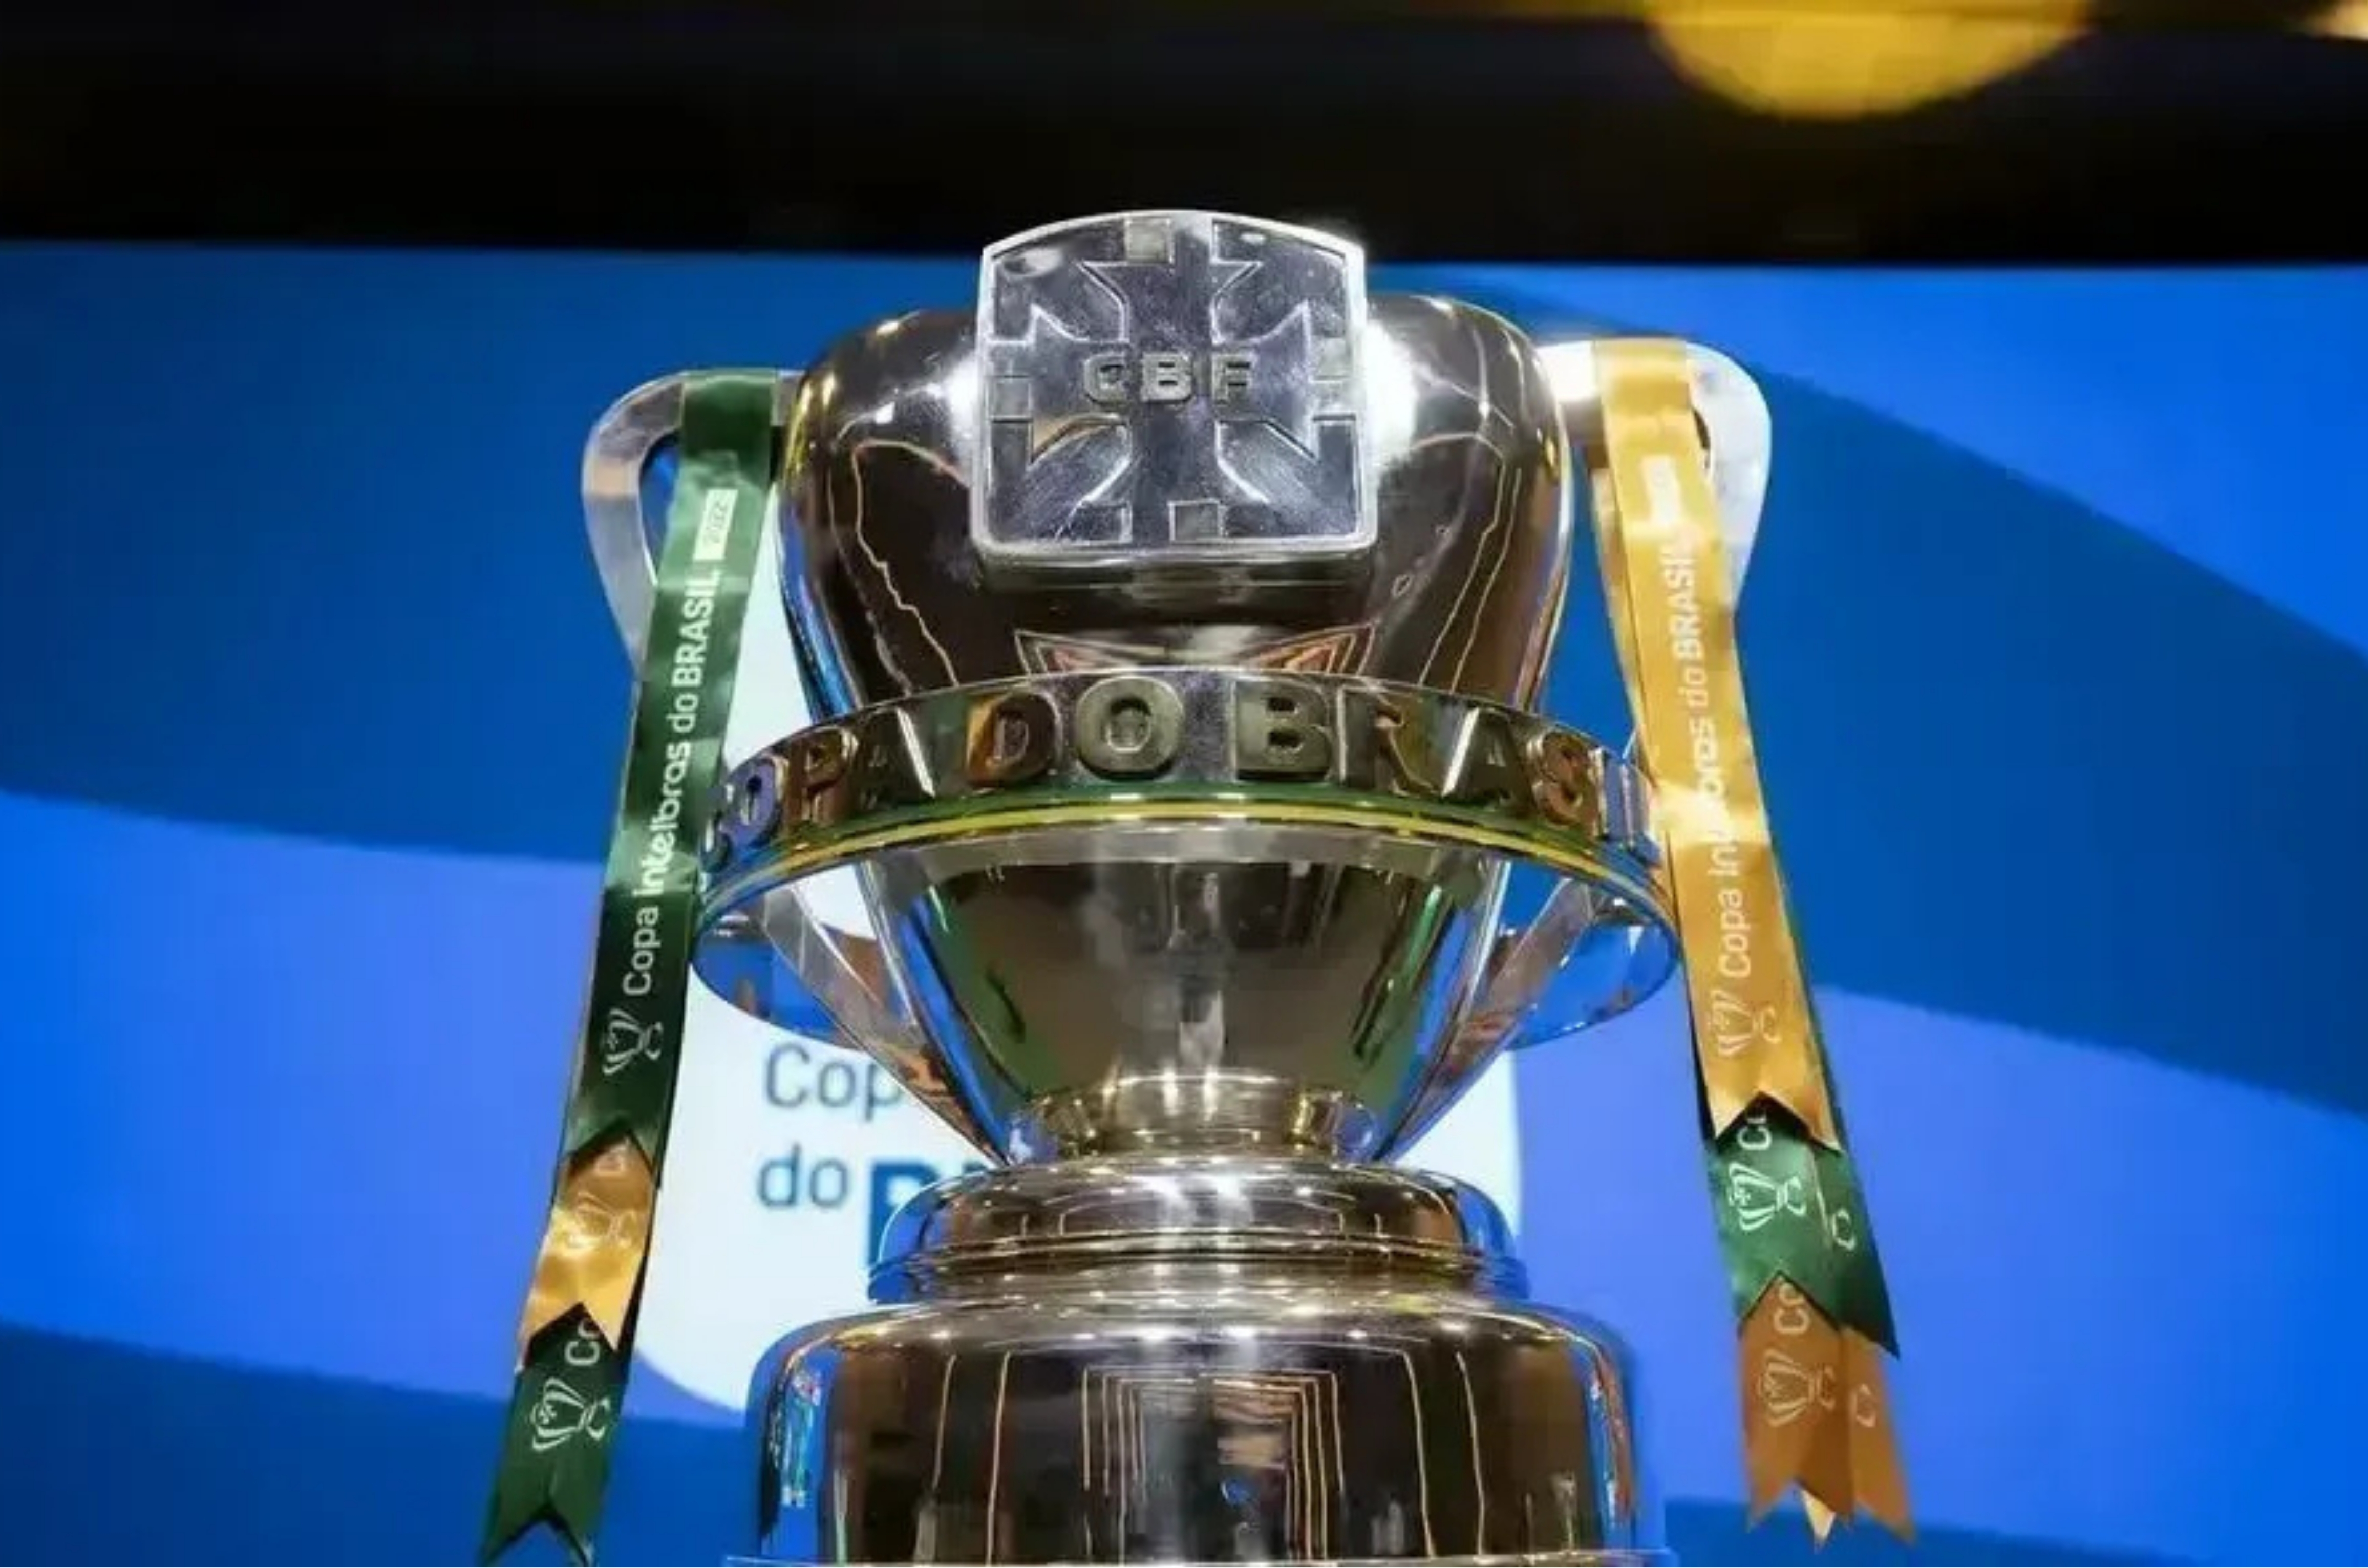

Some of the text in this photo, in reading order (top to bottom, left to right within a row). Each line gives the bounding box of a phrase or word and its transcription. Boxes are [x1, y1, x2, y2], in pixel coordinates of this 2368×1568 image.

[1083, 351, 1254, 405] CBF
[671, 568, 721, 687] BRASIL
[1660, 535, 1704, 660] BRASI
[667, 693, 699, 733] do
[1680, 668, 1709, 707] do
[709, 701, 936, 860] OPA
[965, 675, 1183, 791] DO
[623, 905, 661, 996] Copa
[1719, 887, 1752, 978] Copa
[766, 1042, 904, 1122] Cop
[757, 1143, 850, 1208] do
